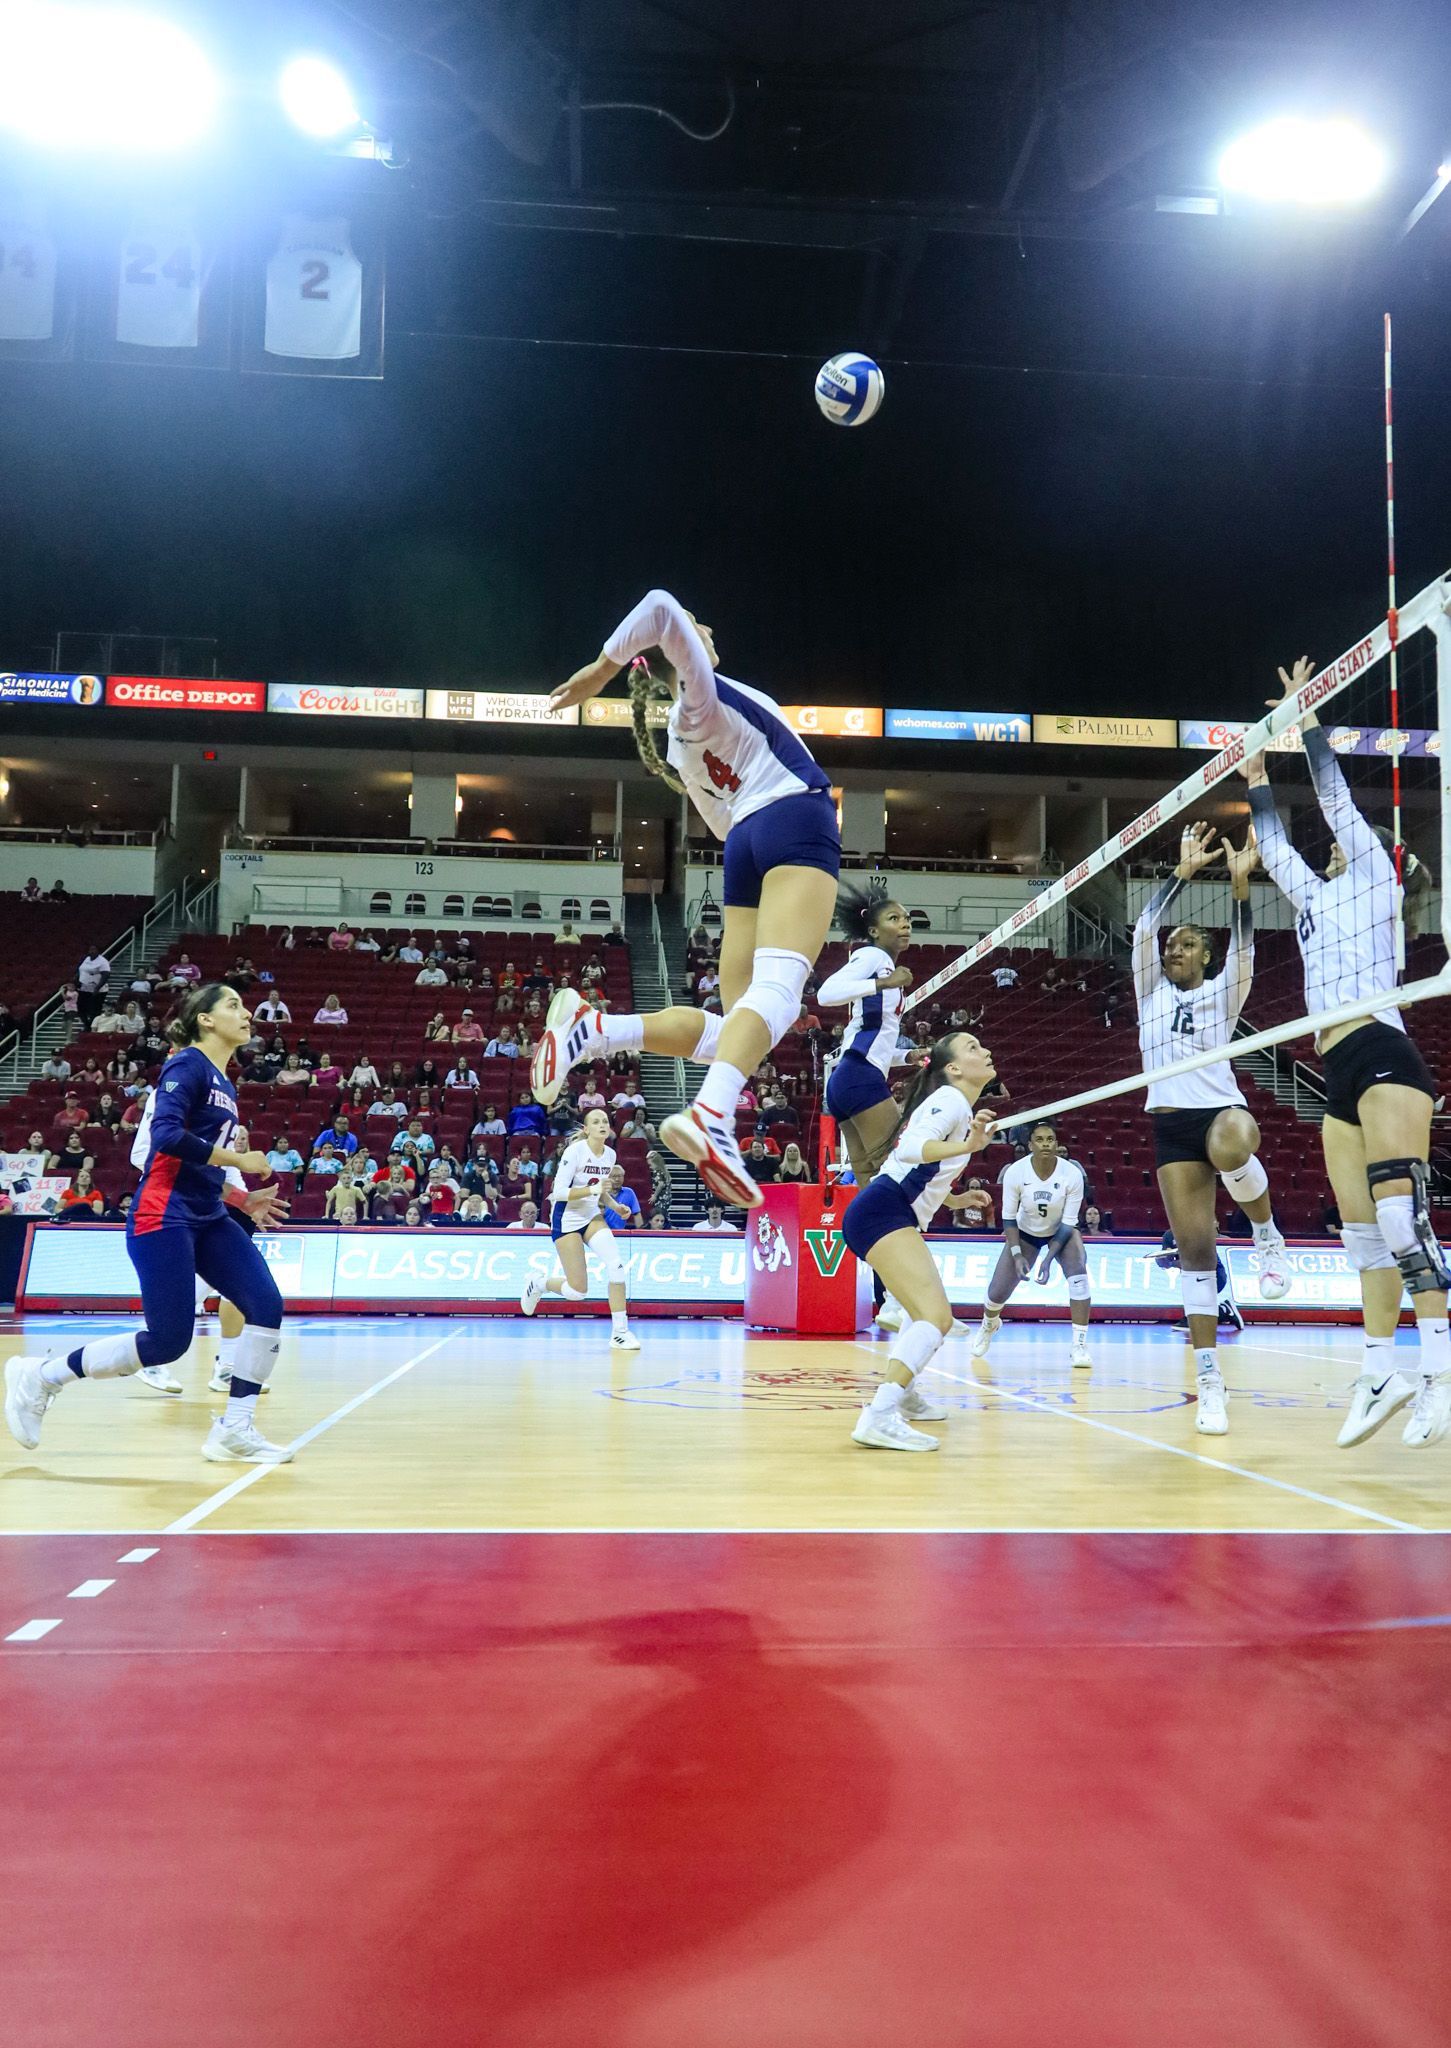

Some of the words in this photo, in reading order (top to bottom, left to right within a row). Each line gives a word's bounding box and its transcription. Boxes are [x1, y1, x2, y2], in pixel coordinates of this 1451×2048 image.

[126, 245, 196, 288] 24
[302, 262, 329, 299] 2
[3, 678, 70, 690] SIMONIAN
[1297, 665, 1338, 714] FRESNO
[1338, 637, 1375, 682] STATE
[27, 688, 68, 698] Medicine
[114, 684, 184, 702] Office
[187, 691, 256, 705] DEPOT
[299, 688, 361, 711] Coors
[364, 698, 420, 713] LIGHT
[449, 696, 473, 705] LIFE
[486, 697, 528, 707] WHOLE
[532, 698, 559, 708] BOD
[449, 706, 473, 715] WTR
[485, 708, 563, 720] HYDRATION
[798, 707, 818, 729] G
[844, 709, 864, 730] G
[893, 717, 967, 730] wchomes.com
[1078, 719, 1154, 737] PALMILLA
[702, 748, 742, 793] 4
[1203, 739, 1245, 786] BULLDOGS
[224, 854, 263, 862] COCKTAILS
[415, 861, 433, 875] 123
[1171, 1005, 1195, 1035] 12
[1037, 1203, 1048, 1218] 5
[803, 1229, 848, 1277] V
[1248, 1253, 1357, 1274] SNGER
[336, 1248, 517, 1281] CLASSIC
